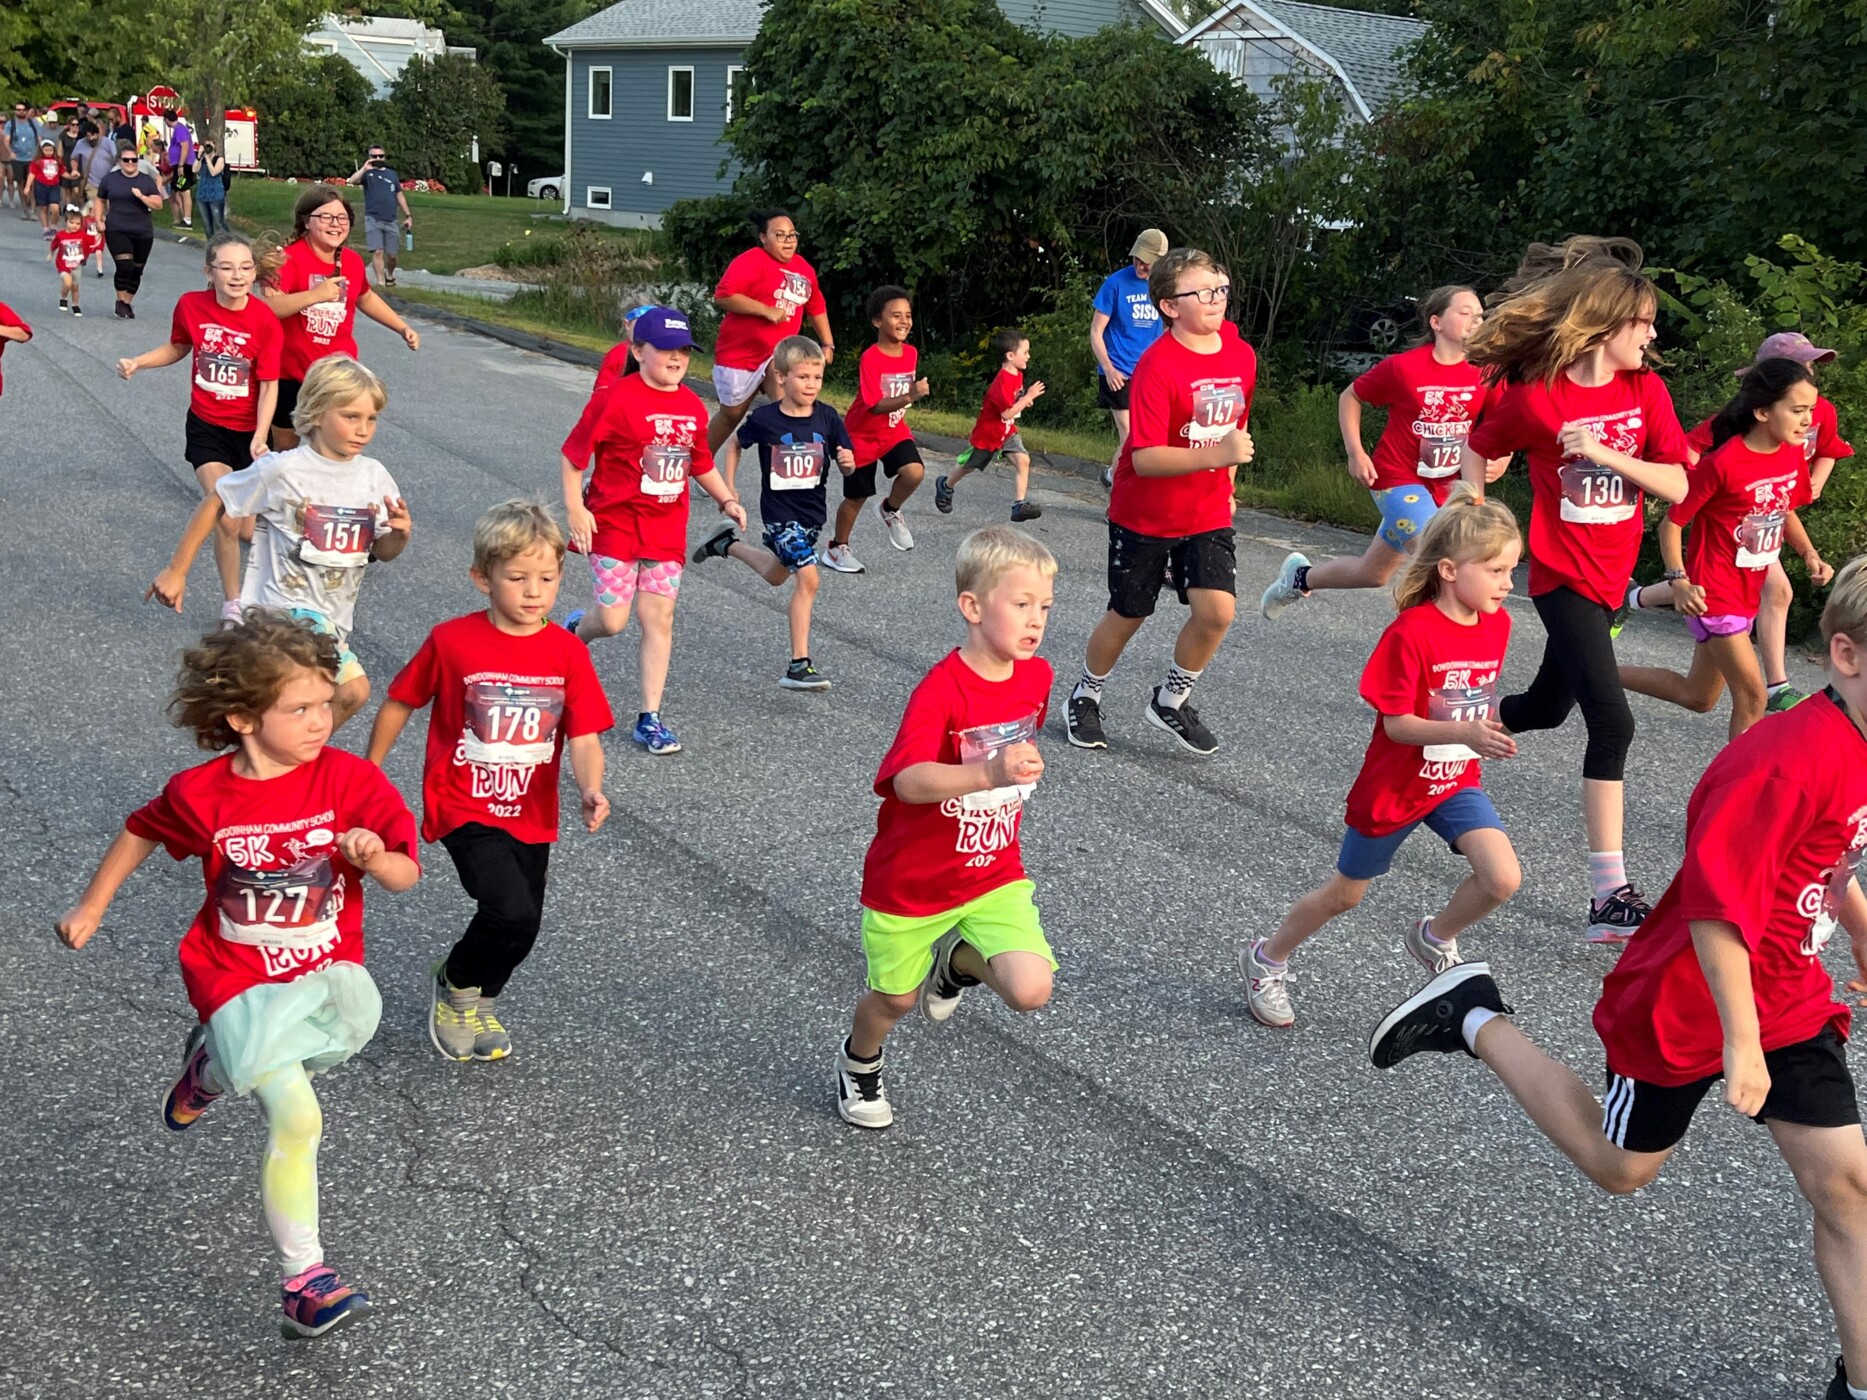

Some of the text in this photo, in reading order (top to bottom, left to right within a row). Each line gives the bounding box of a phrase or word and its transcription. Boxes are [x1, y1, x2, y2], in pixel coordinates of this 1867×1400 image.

[150, 95, 175, 108] STO
[1126, 294, 1148, 303] TEAM
[306, 316, 339, 337] RUN
[208, 363, 238, 385] 165
[1424, 390, 1445, 406] 5K
[1206, 399, 1234, 425] 147
[783, 455, 814, 477] 109
[1433, 446, 1461, 467] 173
[658, 458, 684, 481] 166
[1582, 475, 1624, 505] 130
[324, 521, 361, 550] 151
[1757, 525, 1781, 553] 161
[1442, 669, 1472, 690] 5K
[488, 706, 541, 741] 178
[471, 762, 535, 802] RUN
[487, 802, 522, 817] 2022
[263, 819, 309, 834] COMMUNITY
[956, 815, 1015, 854] RUN
[225, 834, 275, 867] 5K
[239, 885, 309, 922] 127
